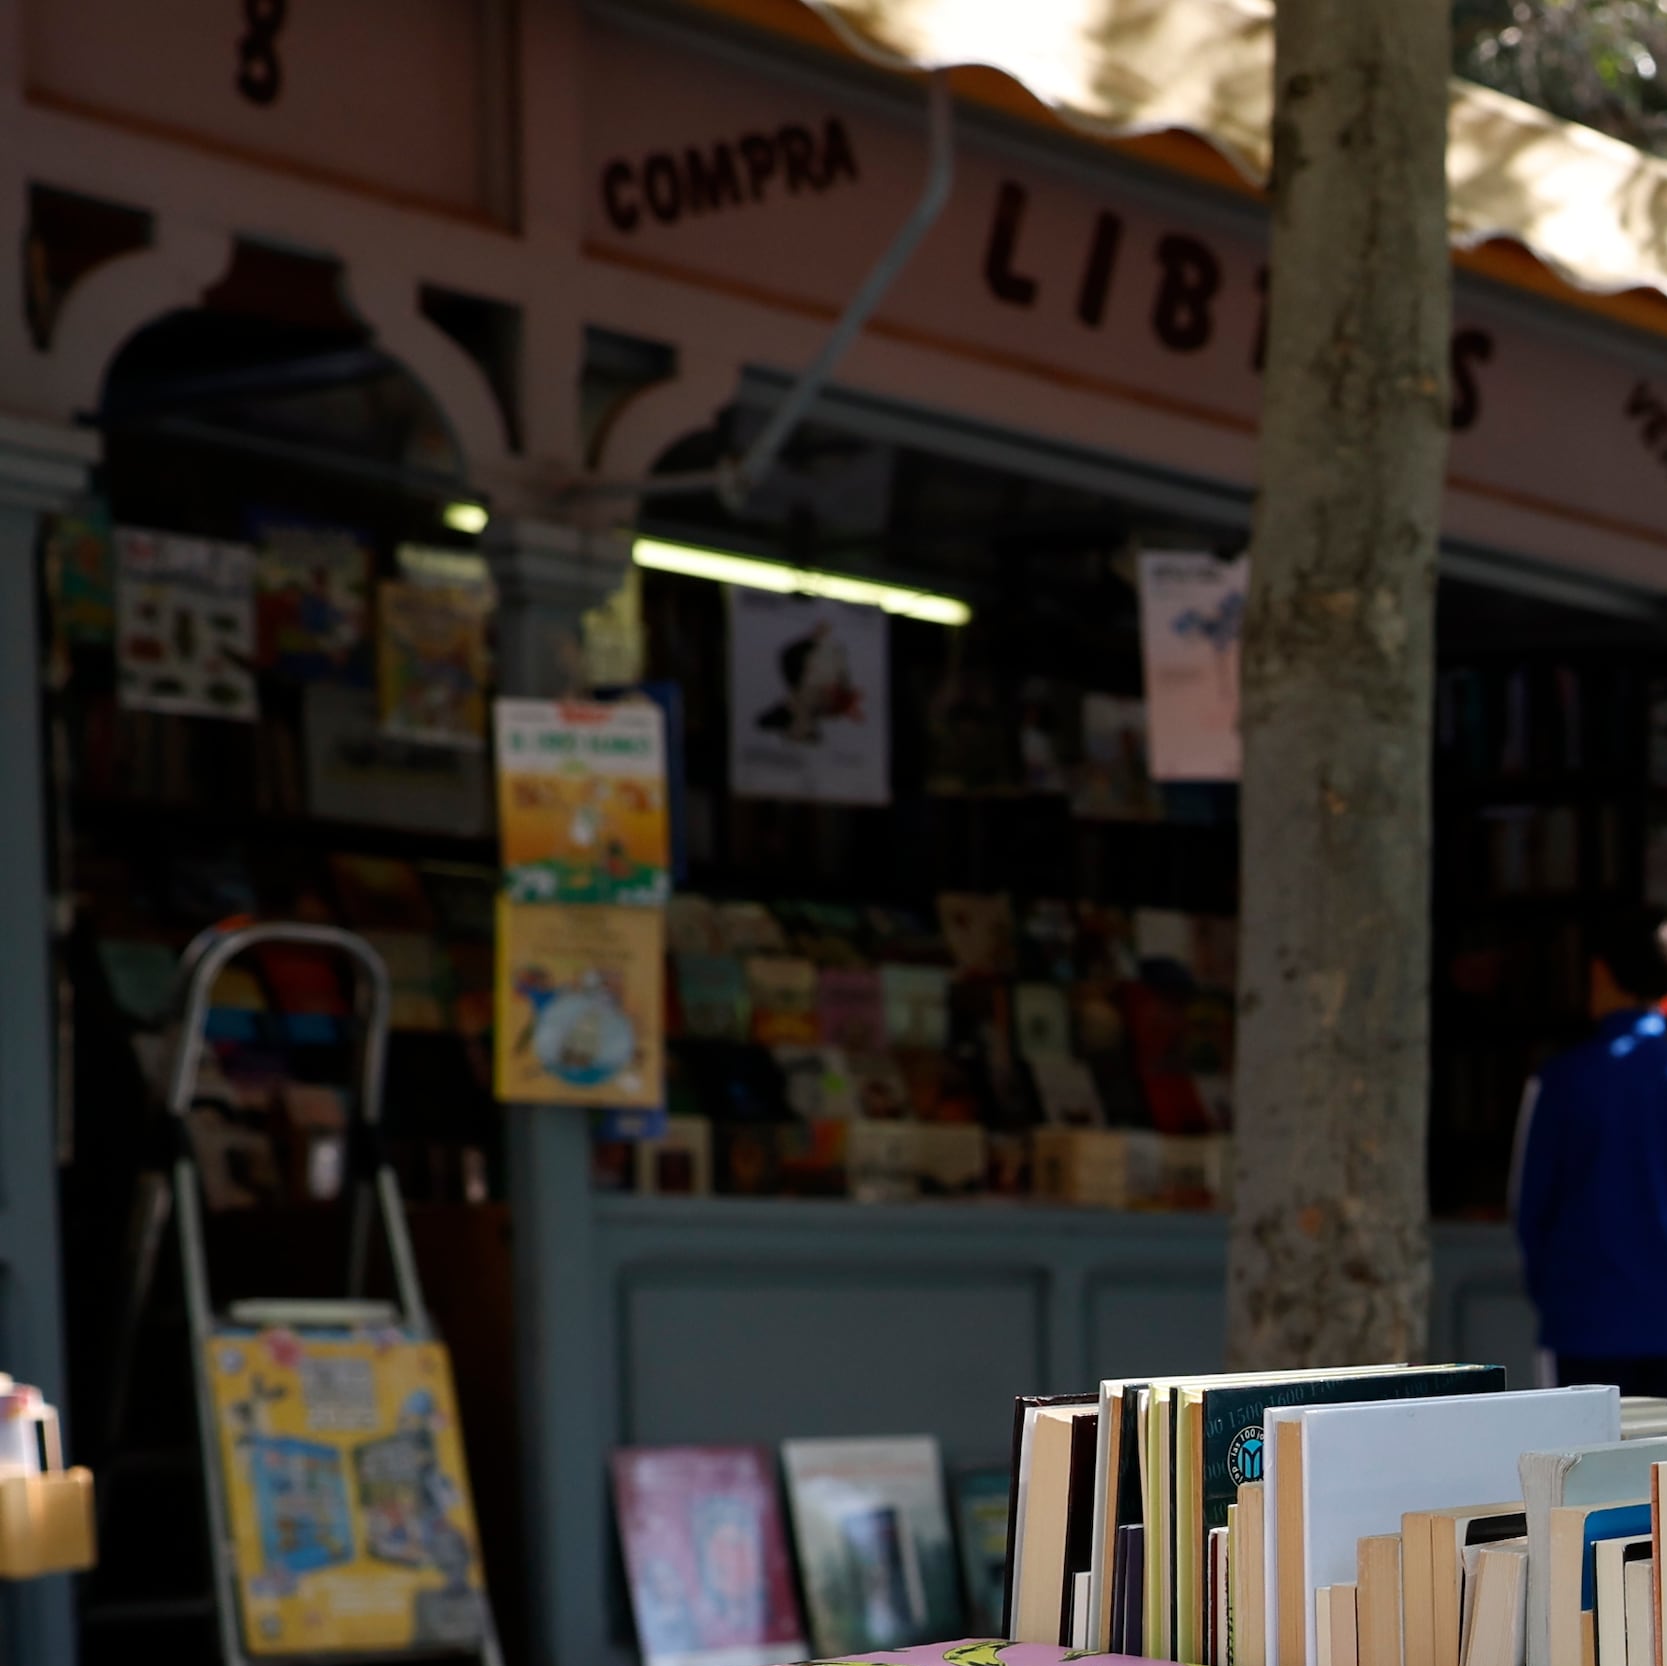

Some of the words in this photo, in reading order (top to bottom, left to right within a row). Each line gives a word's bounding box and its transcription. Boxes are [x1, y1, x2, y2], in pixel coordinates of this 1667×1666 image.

[602, 116, 860, 234] COMPRA
[987, 181, 1493, 430] LIBS
[1230, 1441, 1241, 1458] las
[1240, 1428, 1256, 1442] 100
